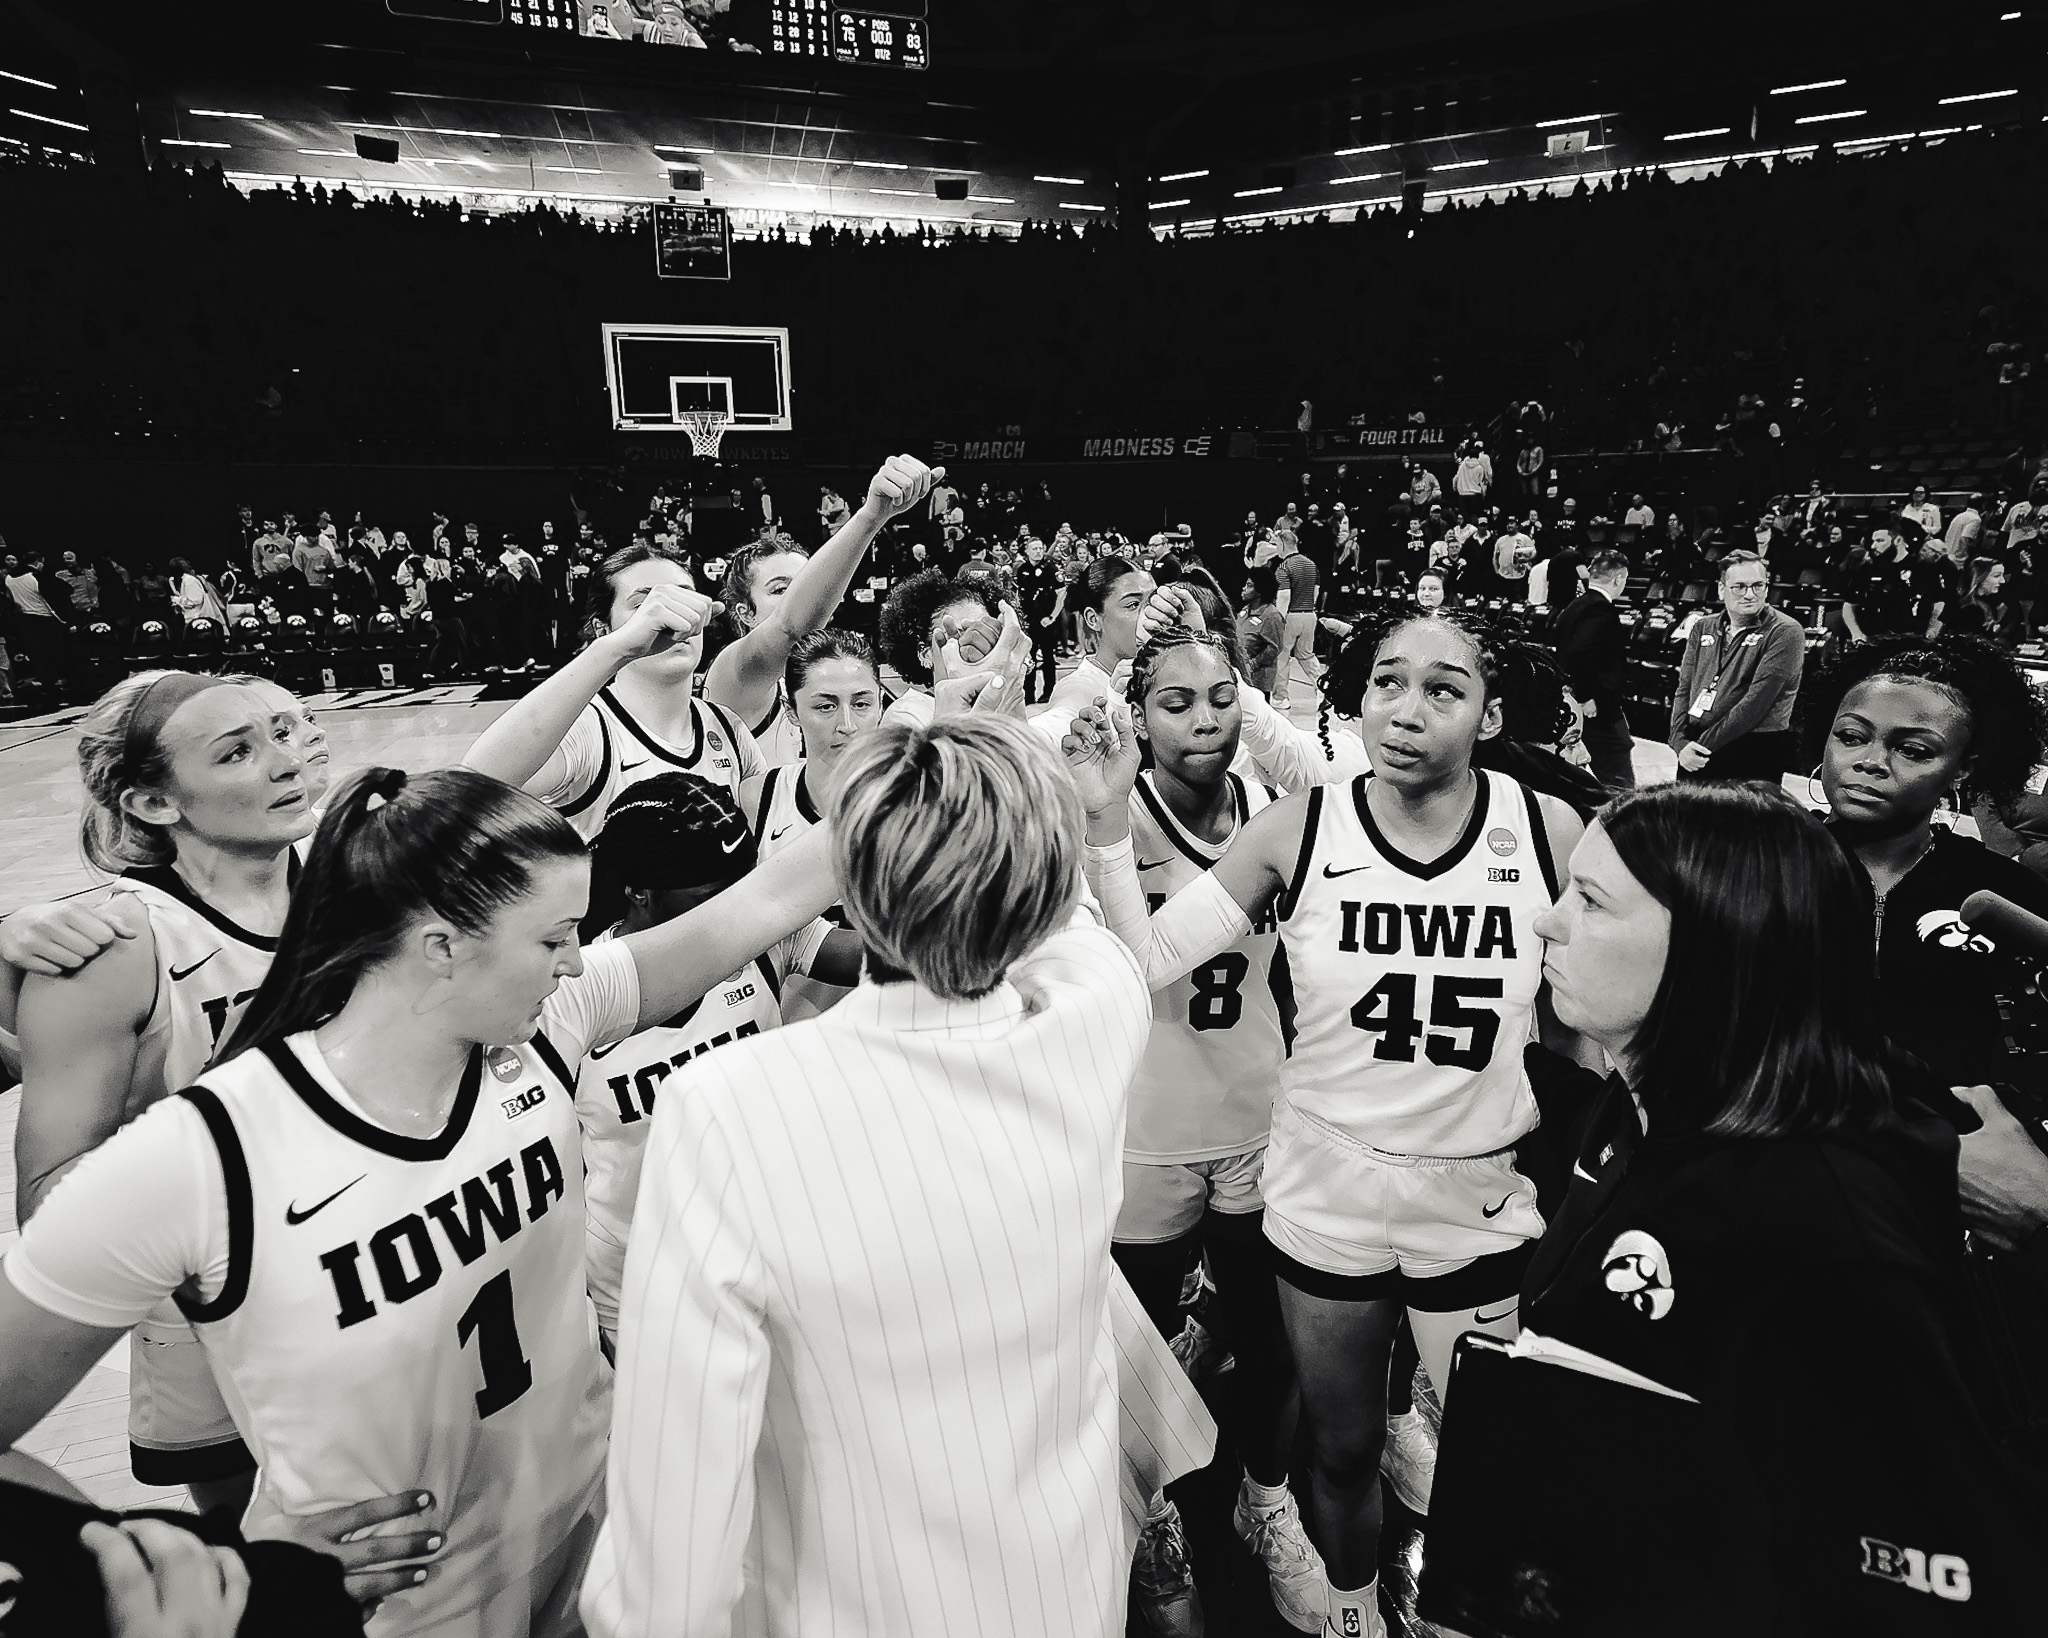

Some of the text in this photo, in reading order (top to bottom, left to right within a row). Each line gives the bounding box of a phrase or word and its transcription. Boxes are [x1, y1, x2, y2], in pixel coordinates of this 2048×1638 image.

[510, 11, 524, 25] 45
[771, 10, 783, 21] 12
[773, 24, 783, 36] 21
[821, 29, 828, 42] 1
[871, 19, 890, 31] POSS
[841, 26, 856, 42] 75
[870, 30, 893, 46] 00.0
[906, 33, 921, 50] 83
[822, 44, 829, 57] 1
[1359, 428, 1445, 445] FOUR IT ALL
[963, 437, 1176, 460] MARCH MADNESS
[1338, 901, 1518, 959] IOWA
[1188, 951, 1250, 1032] 8
[1350, 972, 1504, 1073] 45
[318, 1136, 565, 1331] IOWA
[457, 1268, 533, 1421] 1
